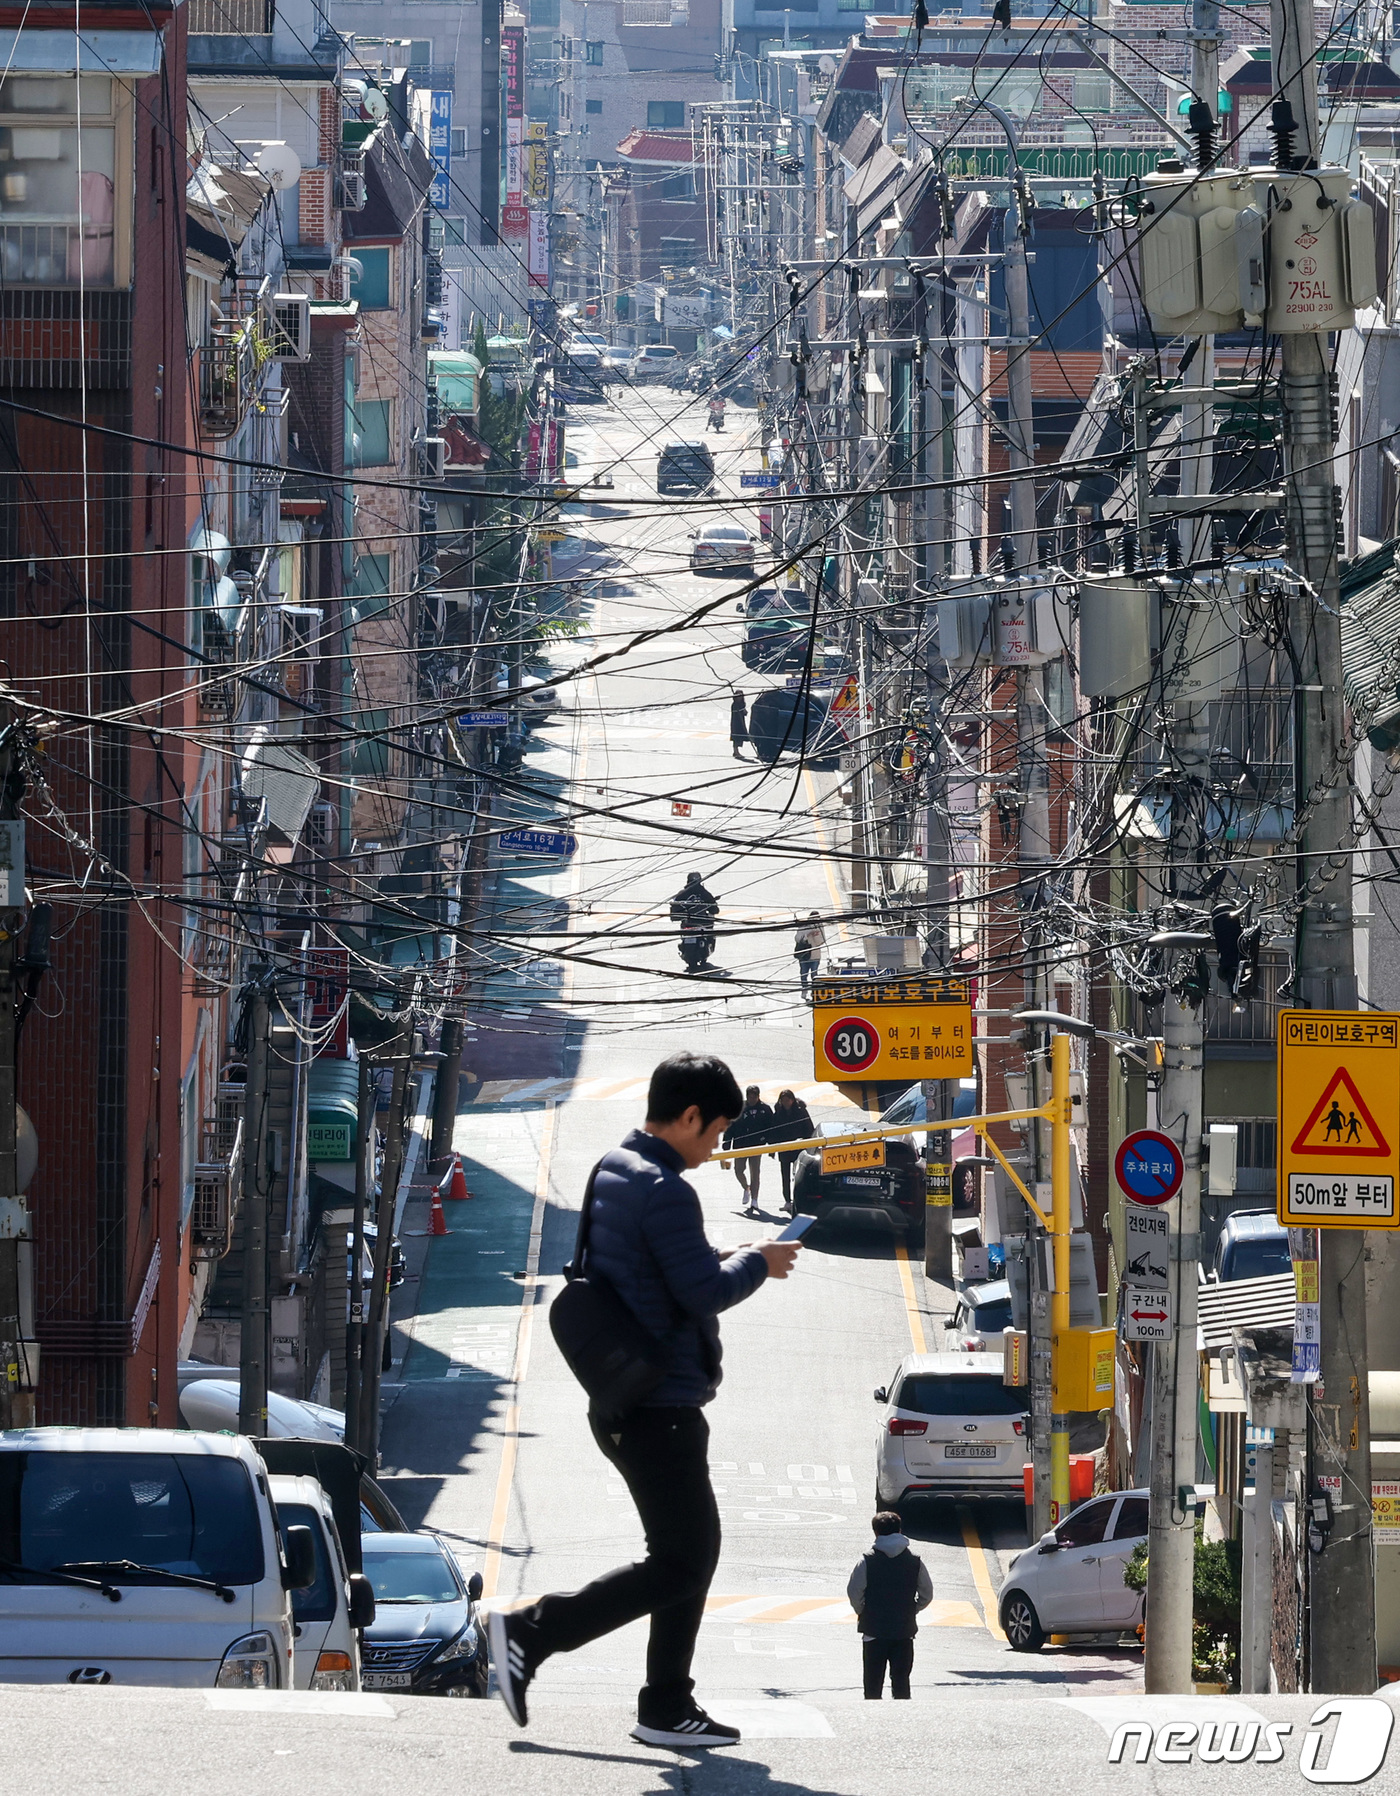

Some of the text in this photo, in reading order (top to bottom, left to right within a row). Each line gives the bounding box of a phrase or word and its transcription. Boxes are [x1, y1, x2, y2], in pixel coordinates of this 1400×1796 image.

[1288, 280, 1332, 300] 75AL
[844, 759, 857, 769] 30
[1289, 1022, 1395, 1044] 어린이보호구역
[837, 1032, 867, 1058] 30
[889, 1045, 966, 1061] 속도를 줄이시오
[826, 1150, 869, 1166] CCTV 작동중
[1126, 1161, 1173, 1175] 주차금지
[1294, 1182, 1388, 1209] 50m앞 부터
[1128, 1215, 1167, 1237] 견인지역
[1136, 1325, 1165, 1337] 100m
[969, 1447, 991, 1456] 0168
[379, 1674, 406, 1687] 7543
